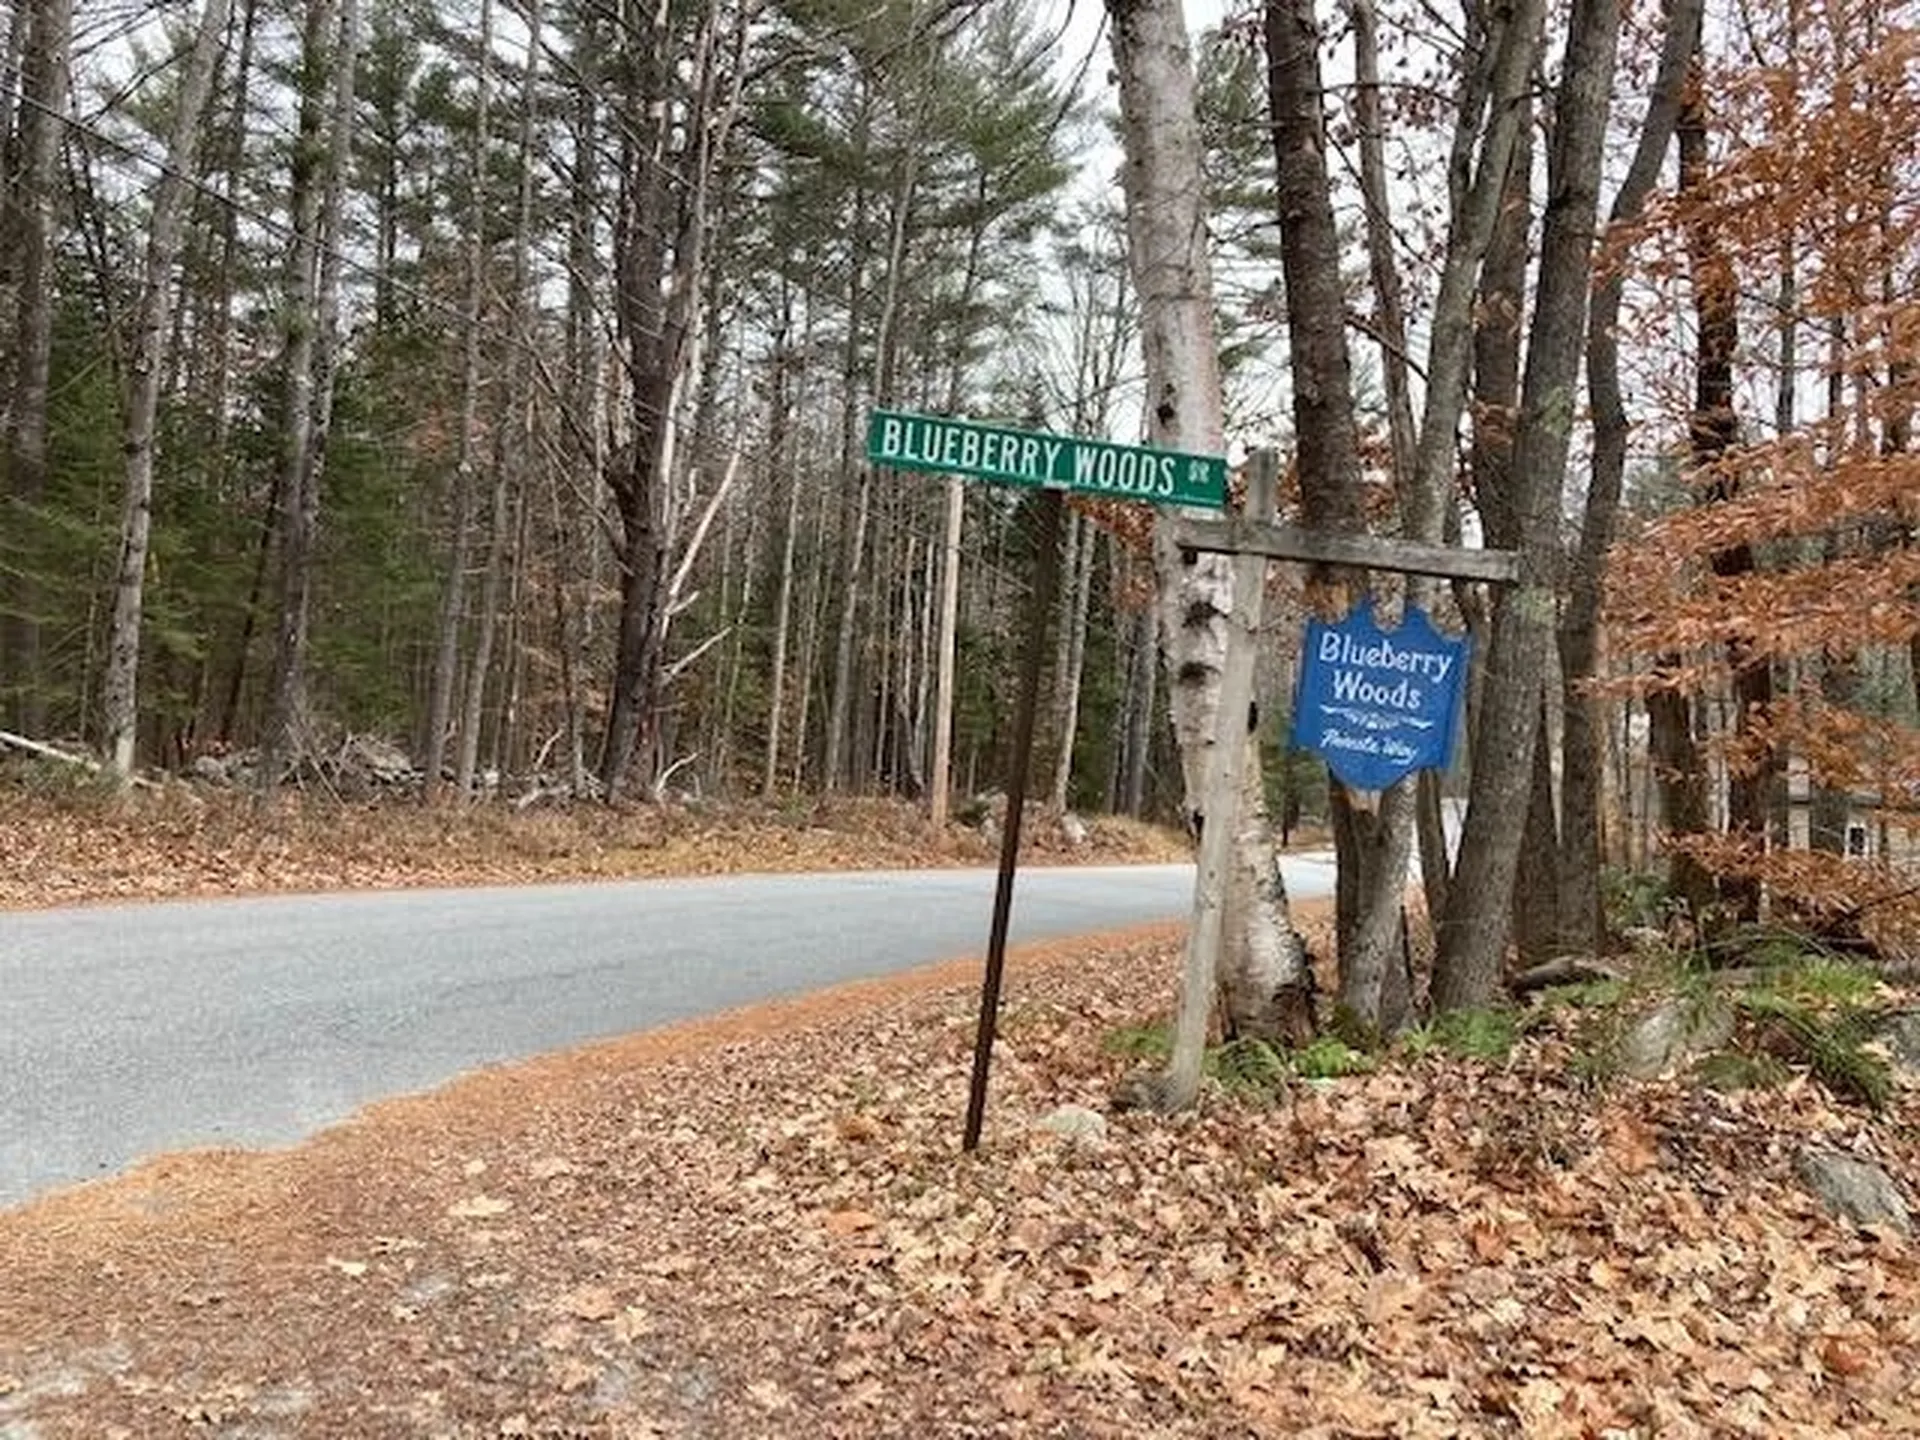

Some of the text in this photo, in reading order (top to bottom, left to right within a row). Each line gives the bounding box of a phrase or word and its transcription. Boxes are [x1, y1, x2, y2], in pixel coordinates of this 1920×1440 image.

[882, 418, 1211, 496] BLUEBERRY WOODS DR
[1319, 631, 1452, 683] Blueberry
[1333, 669, 1422, 709] Woods
[1382, 736, 1418, 765] Way
